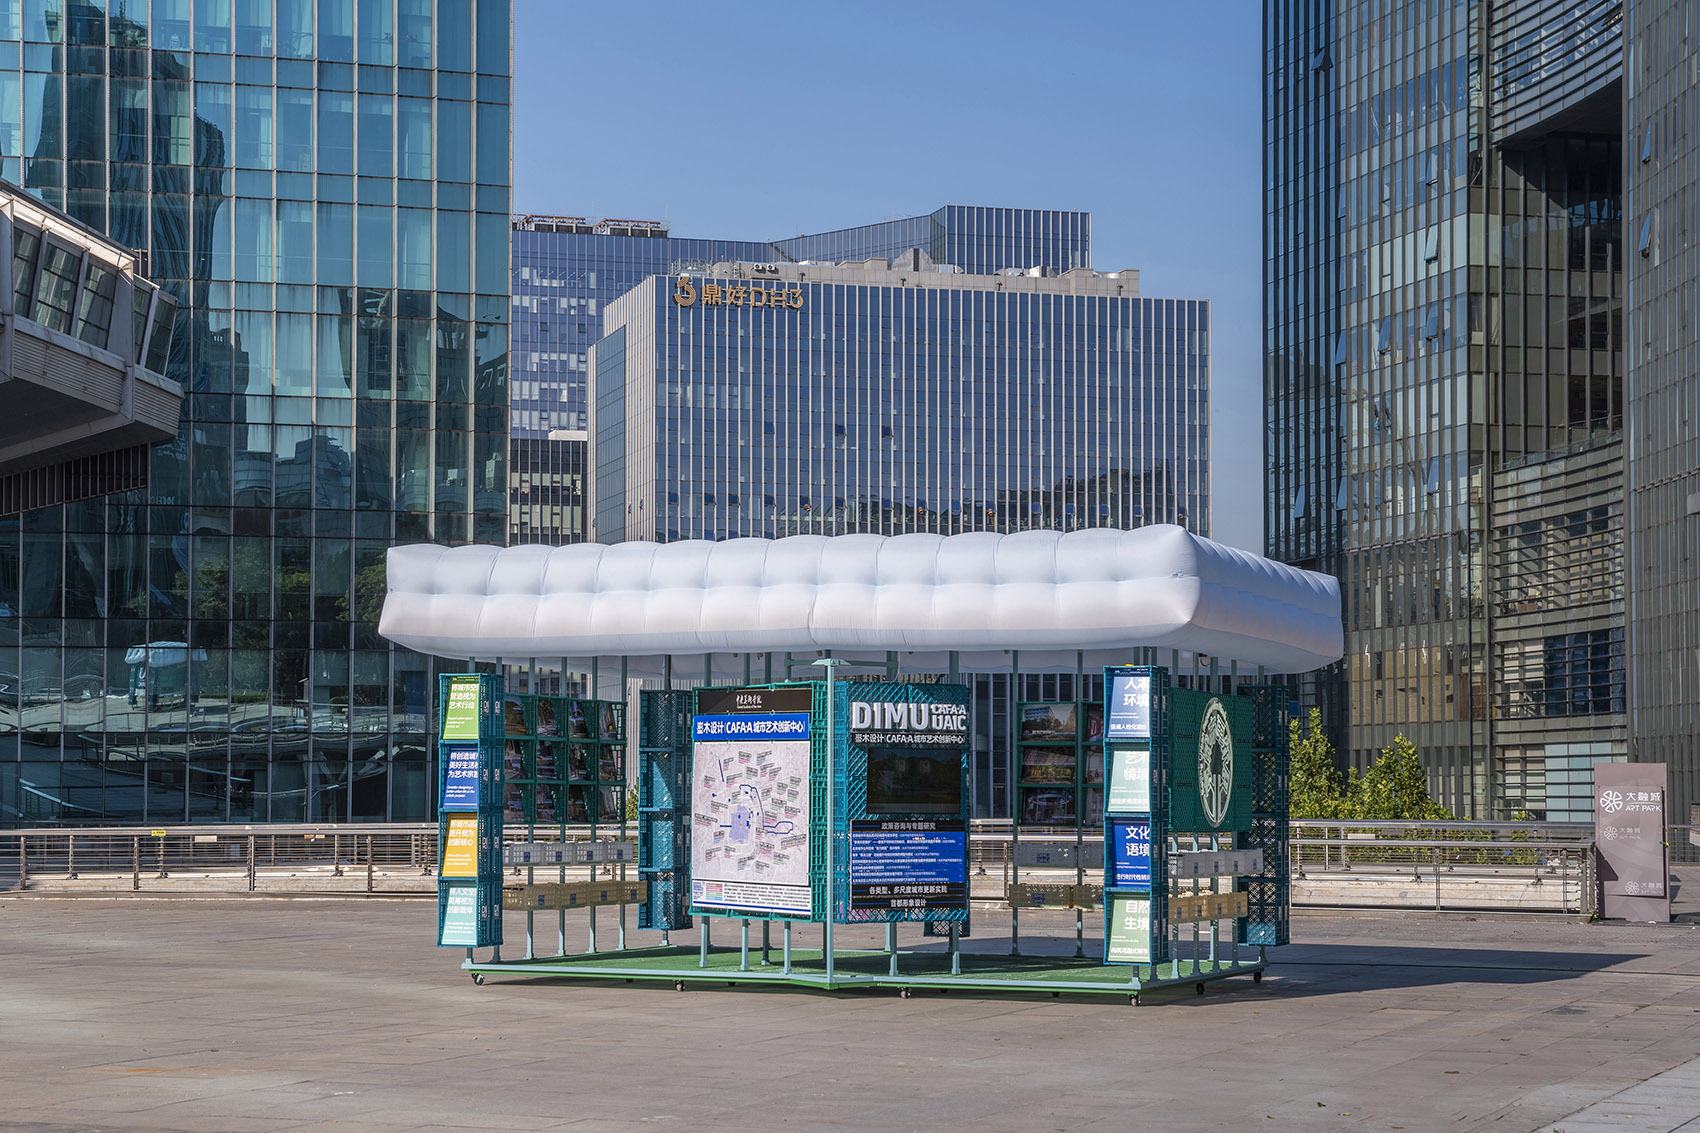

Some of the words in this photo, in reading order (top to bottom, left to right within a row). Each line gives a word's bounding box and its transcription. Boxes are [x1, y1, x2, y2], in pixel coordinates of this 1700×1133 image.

[1123, 694, 1150, 707] 环境
[852, 701, 929, 729] DIMU
[932, 715, 967, 730] UAIC
[1626, 792, 1660, 801] 大融城
[1125, 825, 1150, 840] 文化
[1126, 843, 1150, 857] 语境
[1126, 900, 1150, 913] 自然
[1124, 916, 1150, 930] 生境
